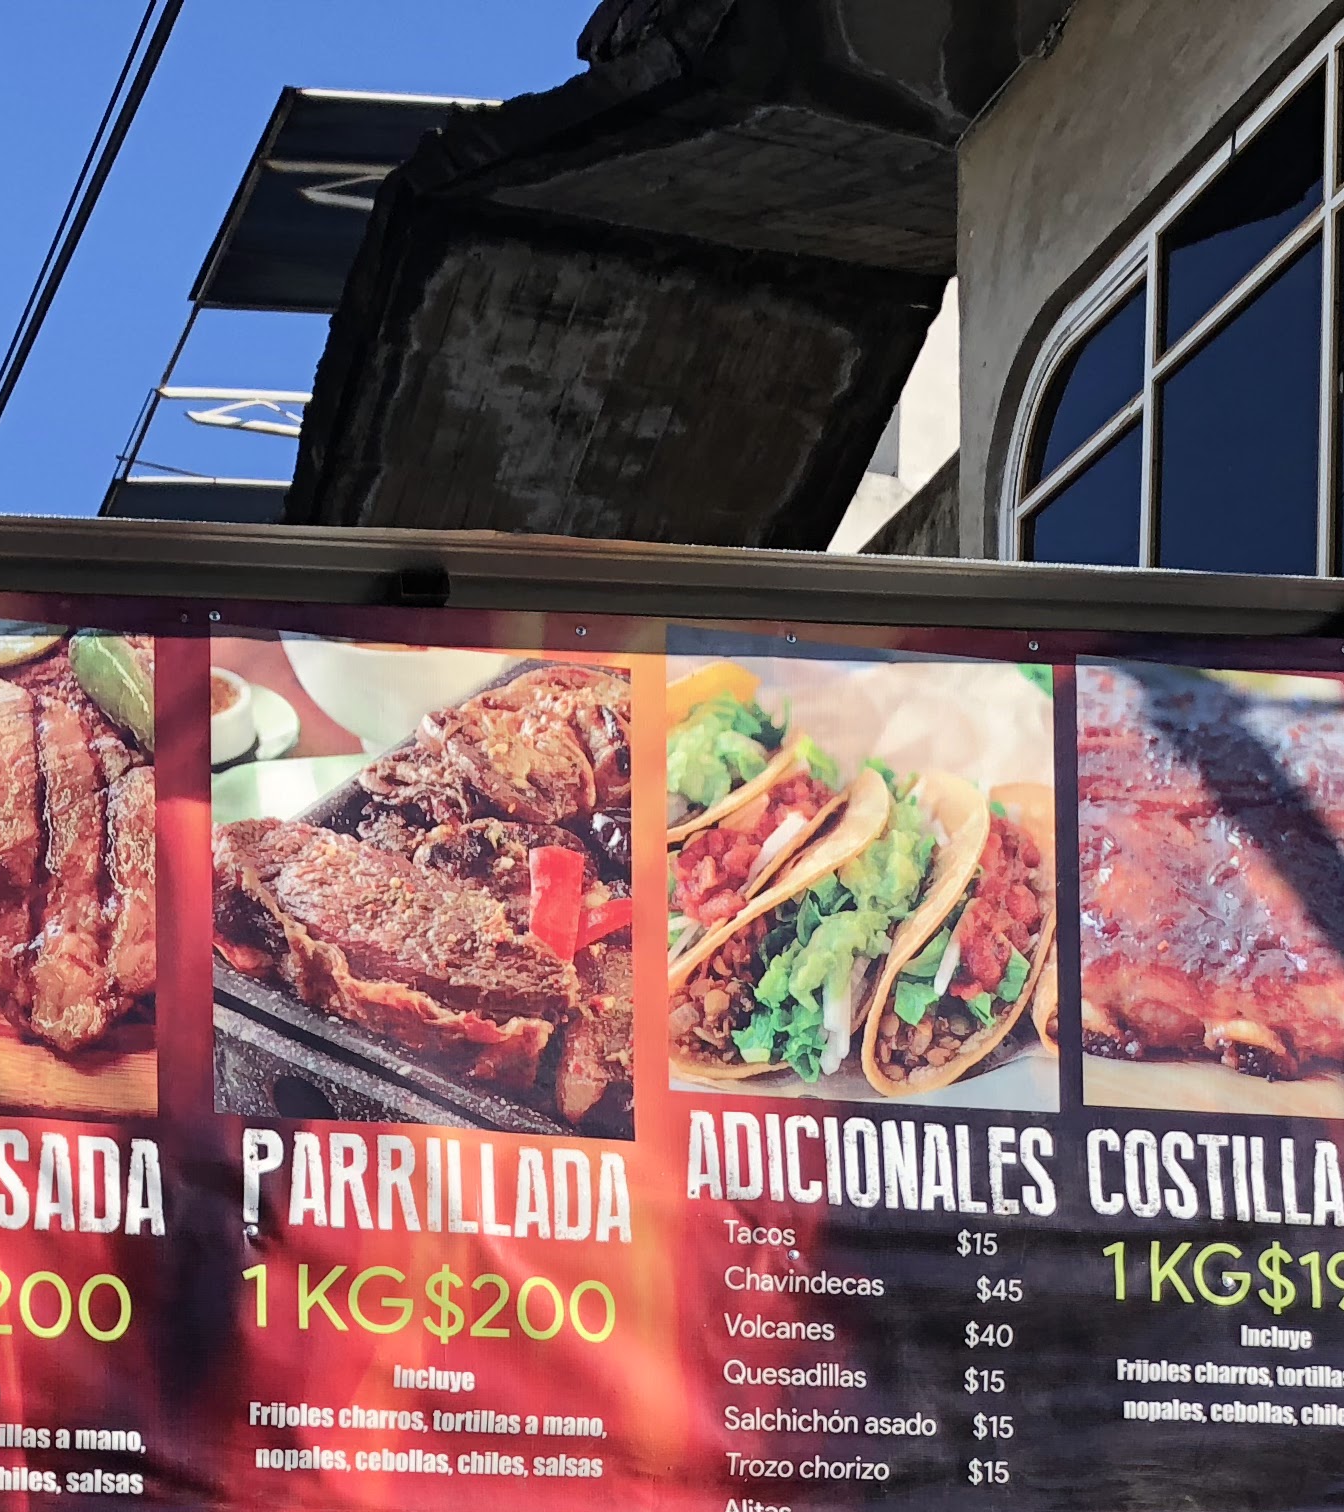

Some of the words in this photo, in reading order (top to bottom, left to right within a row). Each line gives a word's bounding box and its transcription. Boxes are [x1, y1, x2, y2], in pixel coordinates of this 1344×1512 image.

[687, 1110, 1057, 1217] ADICIONALES
[242, 1128, 632, 1243] PARRILLADA
[723, 1220, 796, 1246] Tacos
[956, 1229, 998, 1257] $15
[724, 1266, 884, 1297] Chavindecas
[1102, 1241, 1126, 1300] 1
[242, 1264, 268, 1327] 1
[976, 1275, 1023, 1303] $45
[724, 1313, 835, 1341] Volcanes
[965, 1321, 1013, 1348] $40
[1241, 1325, 1312, 1351] Incluye
[393, 1364, 475, 1391] Incluye
[723, 1360, 867, 1388] Quesadillas
[964, 1367, 1005, 1394] $15
[1117, 1358, 1191, 1384] Frijoles
[1195, 1361, 1273, 1387] charros,
[249, 1401, 333, 1429] Frijoles
[338, 1405, 428, 1433] charros,
[433, 1407, 520, 1434] tortillas
[525, 1417, 538, 1435] a
[543, 1417, 607, 1438] mano,
[724, 1406, 858, 1434] Salchichón
[865, 1412, 937, 1436] asado
[972, 1412, 1014, 1440] $15
[1123, 1399, 1207, 1423] nopales,
[1210, 1400, 1298, 1427] cebollas,
[55, 1430, 70, 1449] a
[75, 1429, 146, 1454] mano,
[256, 1445, 351, 1471] nopales,
[355, 1448, 453, 1475] cebollas,
[457, 1451, 528, 1477] chiles,
[533, 1454, 603, 1478] salsas
[725, 1452, 793, 1479] Trozo
[799, 1455, 889, 1481] chorizo
[967, 1458, 1009, 1485] $15
[66, 1469, 144, 1494] salsas
